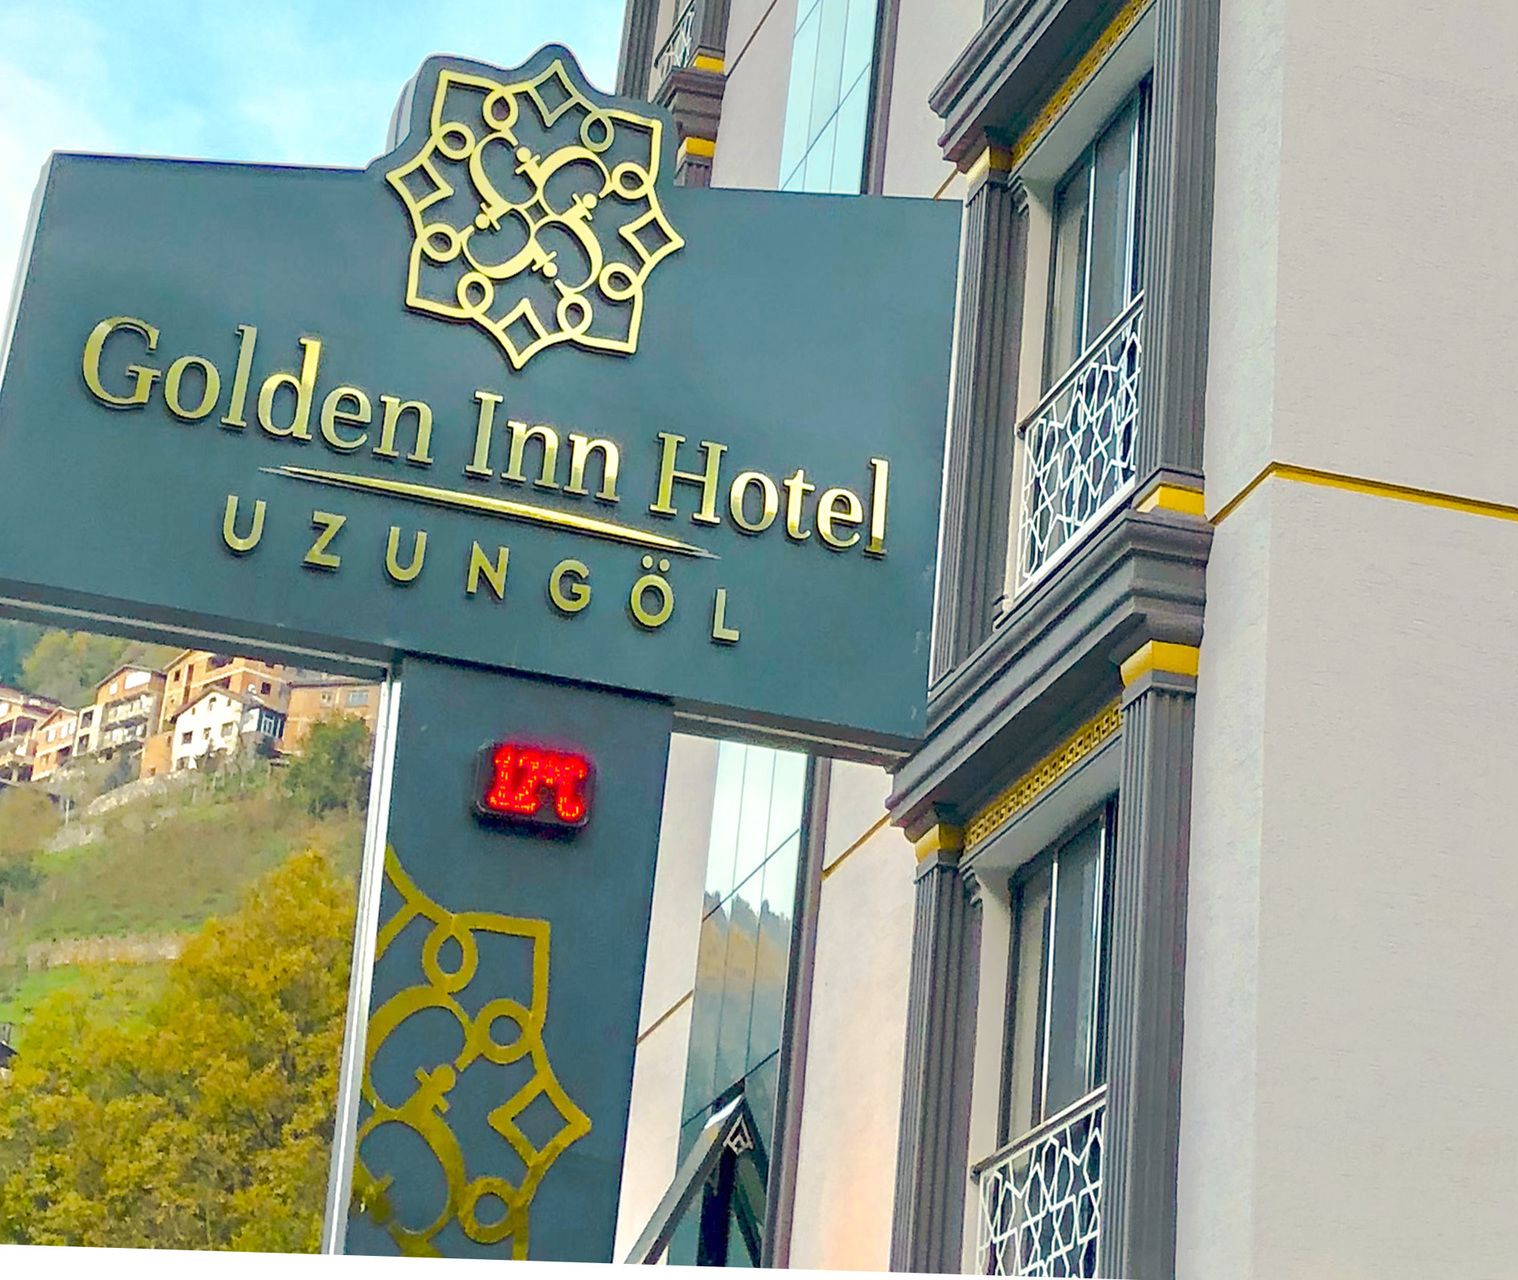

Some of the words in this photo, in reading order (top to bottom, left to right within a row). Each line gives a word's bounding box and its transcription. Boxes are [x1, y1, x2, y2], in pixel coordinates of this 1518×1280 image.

[82, 316, 434, 467] Golden
[463, 390, 622, 504] Inn
[649, 430, 891, 557] Hotel
[221, 494, 741, 644] UZUNGÖL
